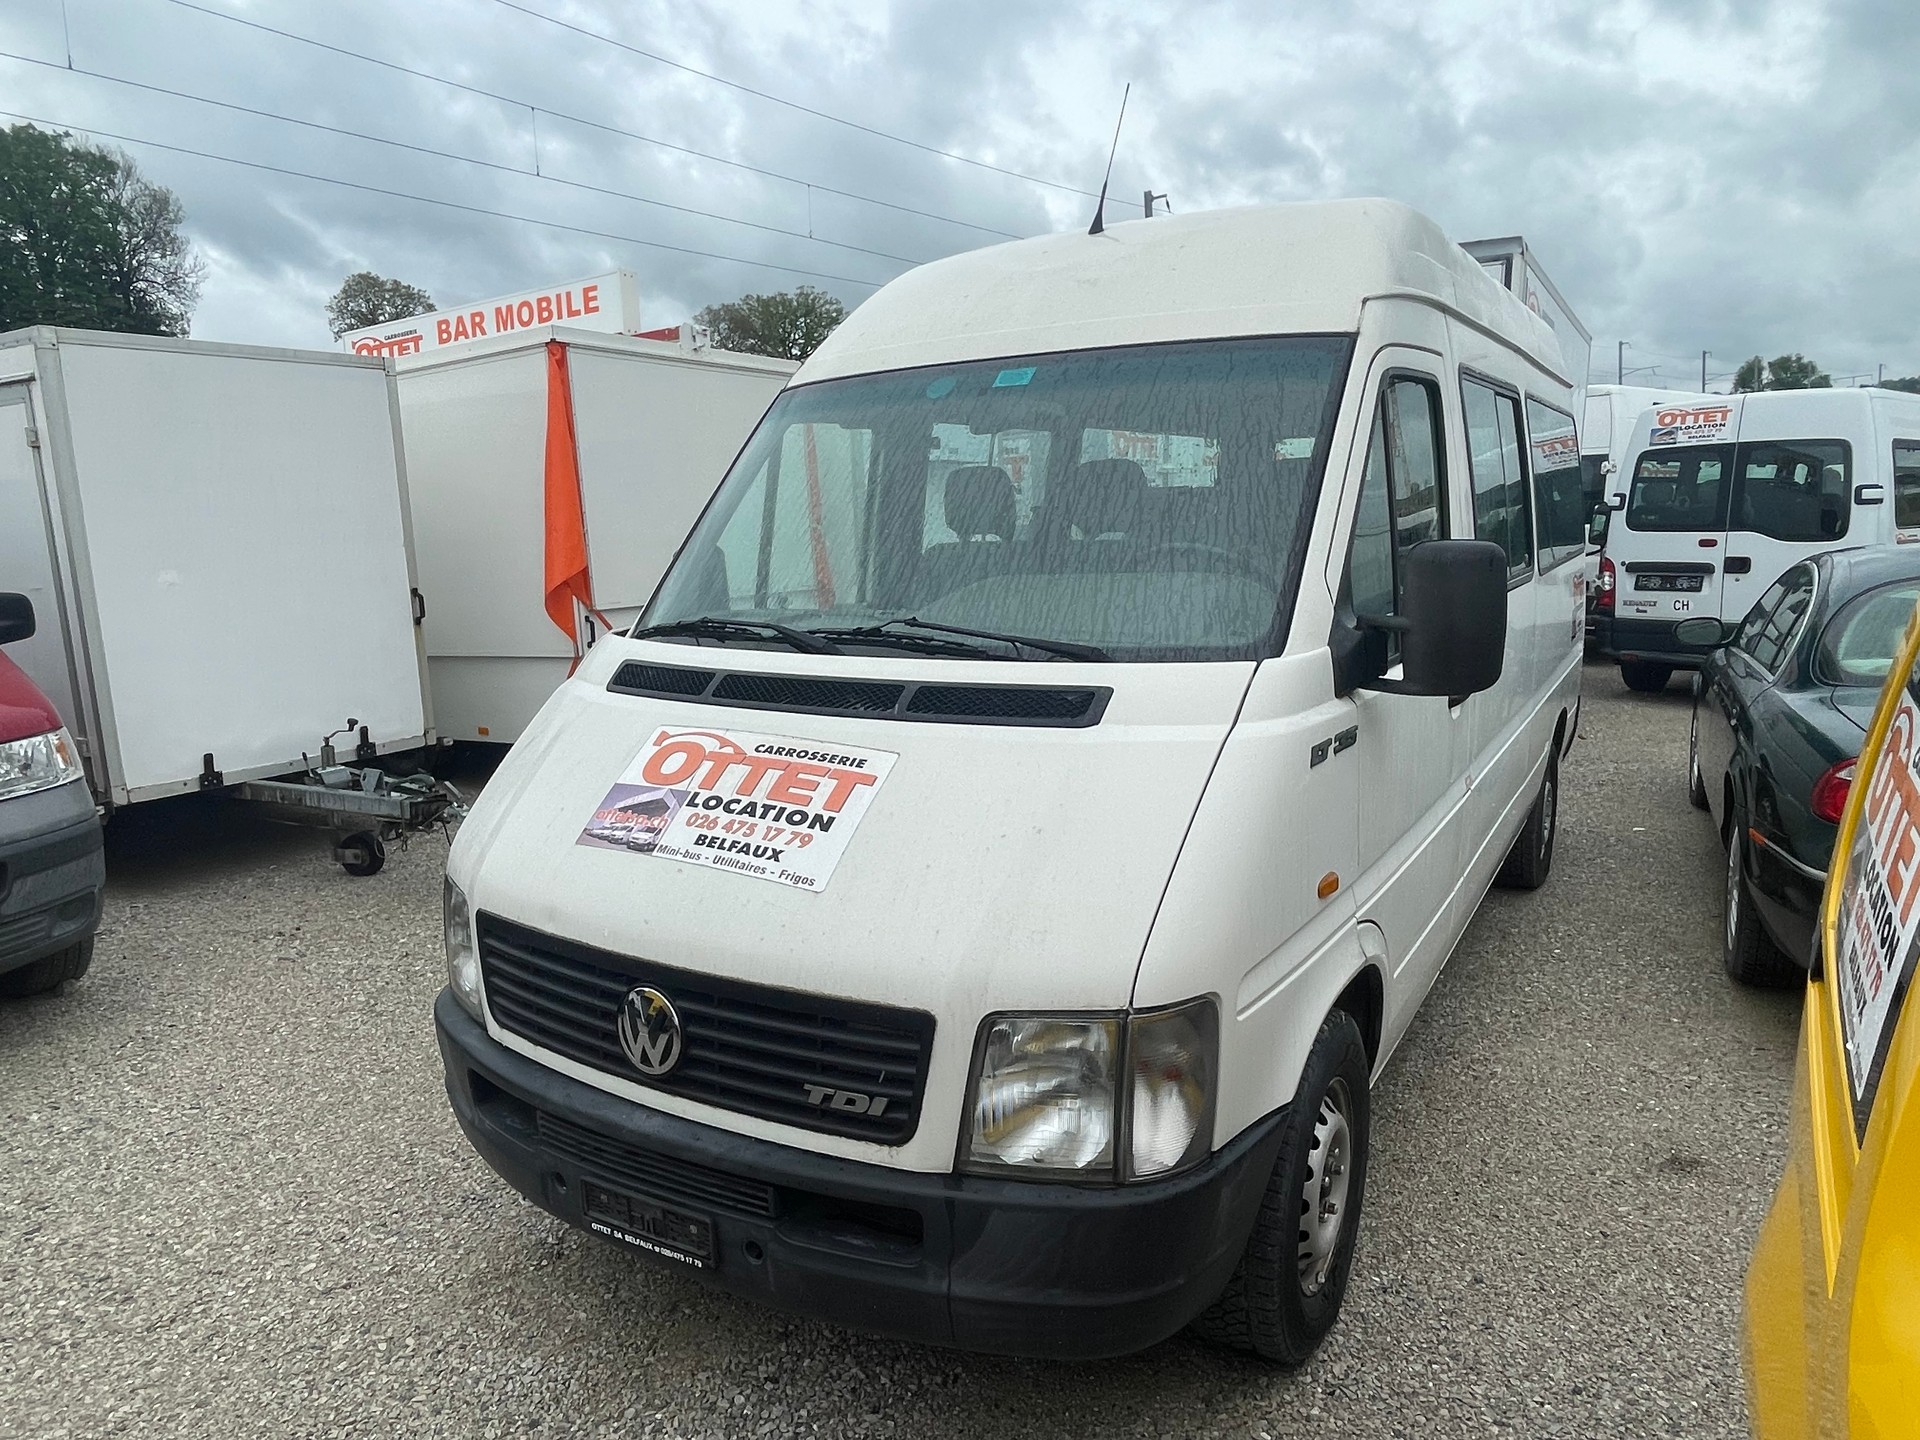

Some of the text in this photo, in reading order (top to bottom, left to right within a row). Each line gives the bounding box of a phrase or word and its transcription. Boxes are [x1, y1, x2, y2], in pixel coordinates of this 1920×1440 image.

[436, 285, 600, 345] BAR MOBILE
[353, 335, 423, 358] OTTET
[384, 329, 418, 340] CARROSSERIE
[1657, 409, 1733, 427] OTTET
[1679, 422, 1726, 431] LOCATION
[1673, 599, 1690, 611] CH
[754, 743, 868, 769] CARROSSERIE
[642, 737, 878, 814] OTTET
[685, 791, 837, 833] LOCATION
[685, 812, 814, 849] 026 475 17 79
[693, 833, 786, 863] BELFAUX
[656, 844, 703, 861] Mini-bus
[712, 855, 767, 875] Utilitaires
[778, 869, 816, 887] Frigos
[1864, 850, 1900, 973] LOCATION
[803, 1083, 888, 1117] TDI
[591, 1222, 611, 1235] OTTET
